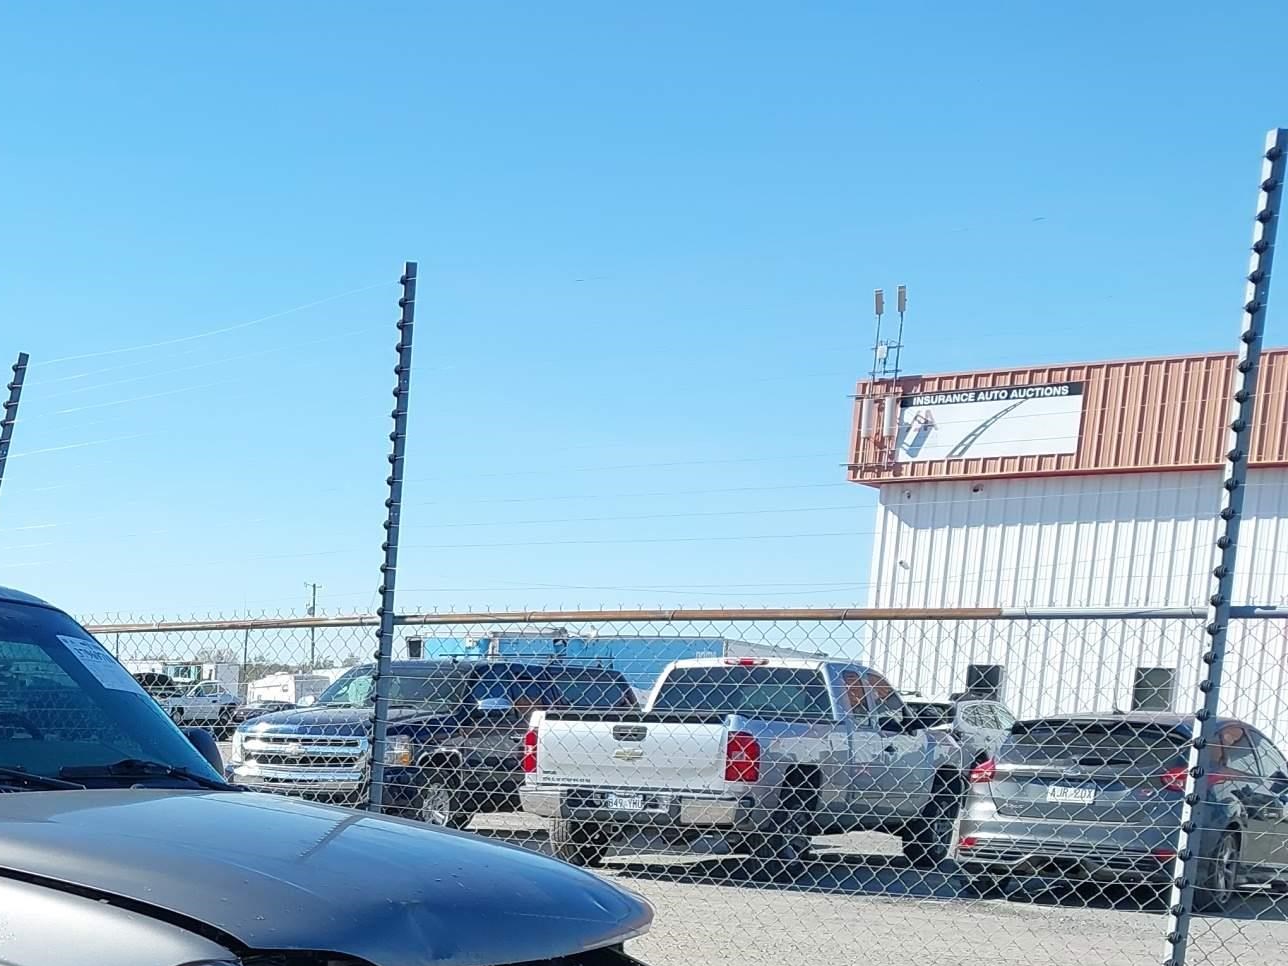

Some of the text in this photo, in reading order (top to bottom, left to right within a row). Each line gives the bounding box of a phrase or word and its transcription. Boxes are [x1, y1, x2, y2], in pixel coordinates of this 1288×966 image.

[912, 385, 1070, 406] INSURANCE AUTO AUCTIONS
